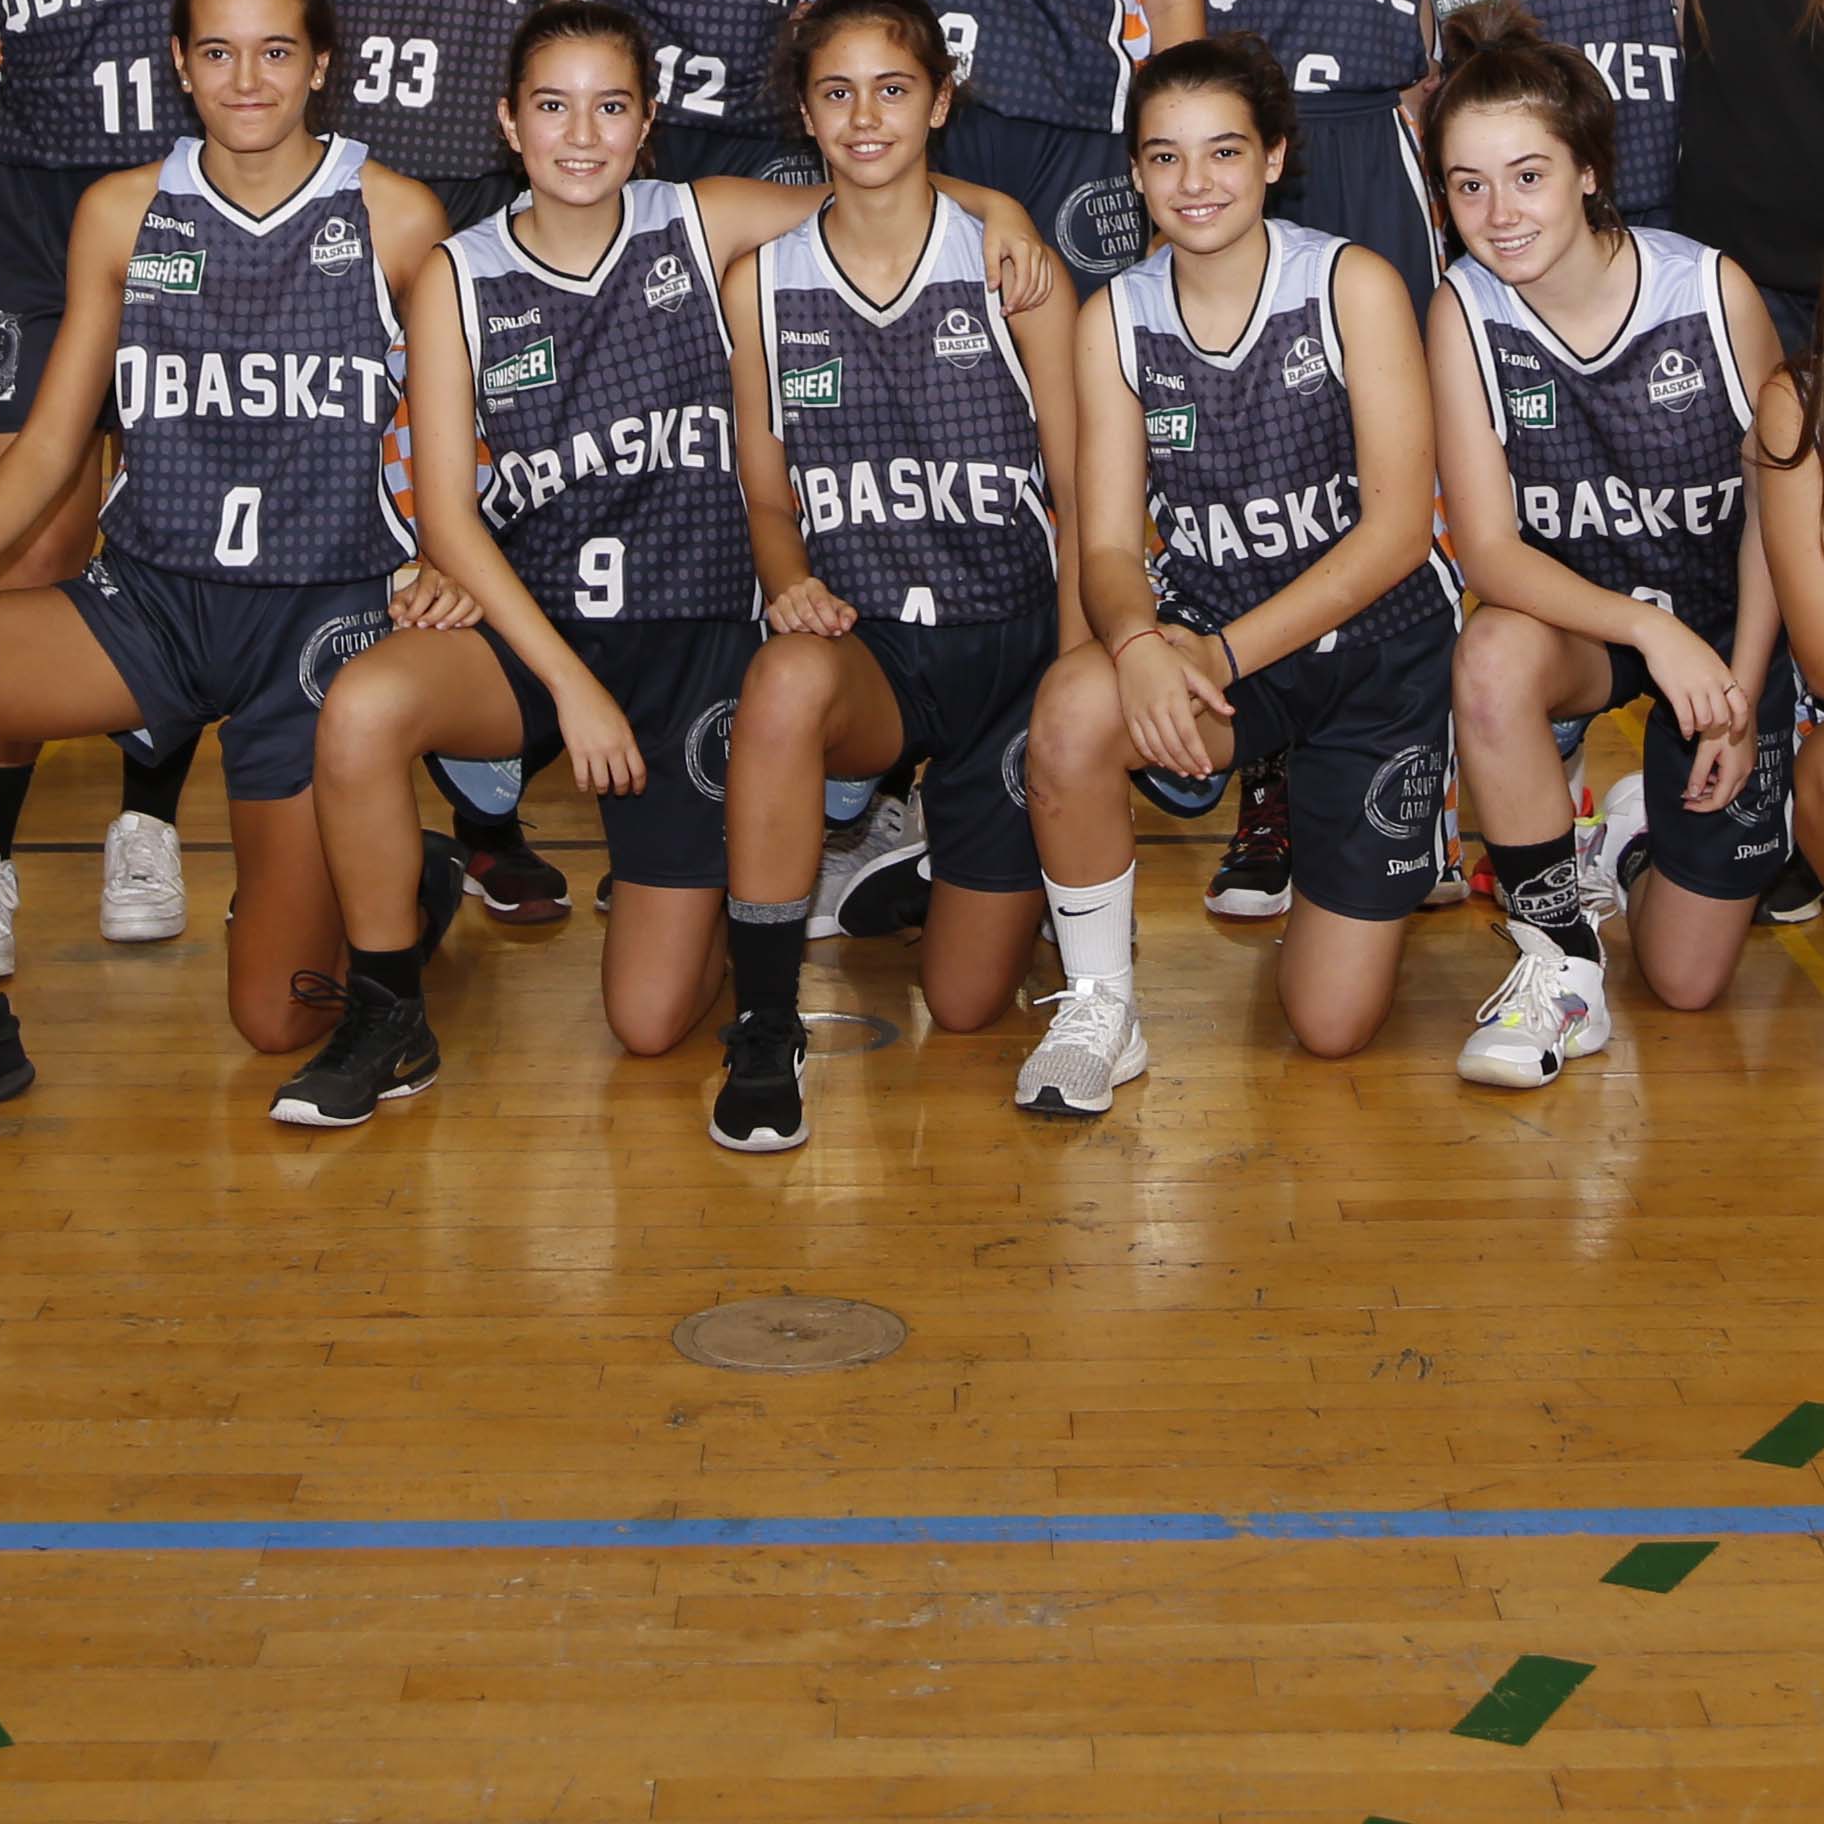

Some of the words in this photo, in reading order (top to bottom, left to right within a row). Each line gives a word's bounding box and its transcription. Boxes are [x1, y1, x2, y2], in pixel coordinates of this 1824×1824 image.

[353, 36, 439, 108] 33
[654, 44, 728, 117] 12
[93, 57, 153, 134] 11
[325, 218, 345, 242] Q
[127, 259, 195, 284] FINISHER
[947, 310, 970, 334] Q
[939, 337, 986, 352] BASKET
[1661, 351, 1683, 376] Q
[116, 344, 385, 430] QBASKET
[1653, 377, 1699, 397] BASKET
[214, 487, 262, 566] 0
[574, 537, 627, 619] 9
[332, 631, 375, 654] CIUTAT
